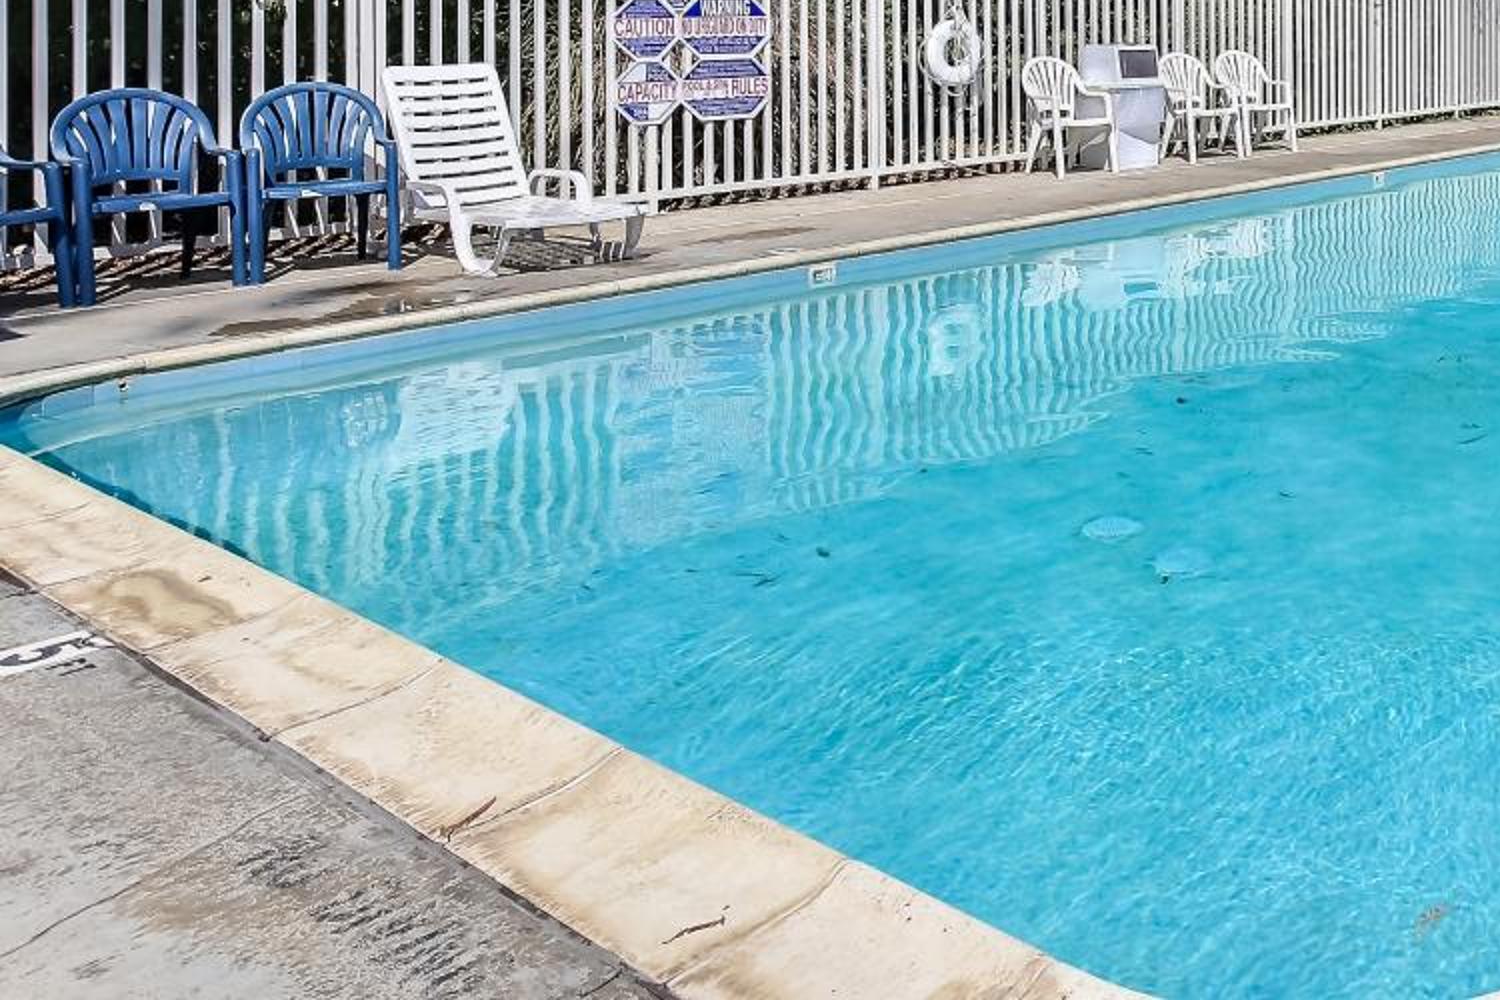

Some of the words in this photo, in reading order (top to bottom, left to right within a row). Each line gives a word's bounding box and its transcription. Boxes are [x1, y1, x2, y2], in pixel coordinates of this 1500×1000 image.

[613, 19, 676, 37] CAUTION
[617, 81, 677, 103] CAPACITY
[731, 78, 769, 96] RULES
